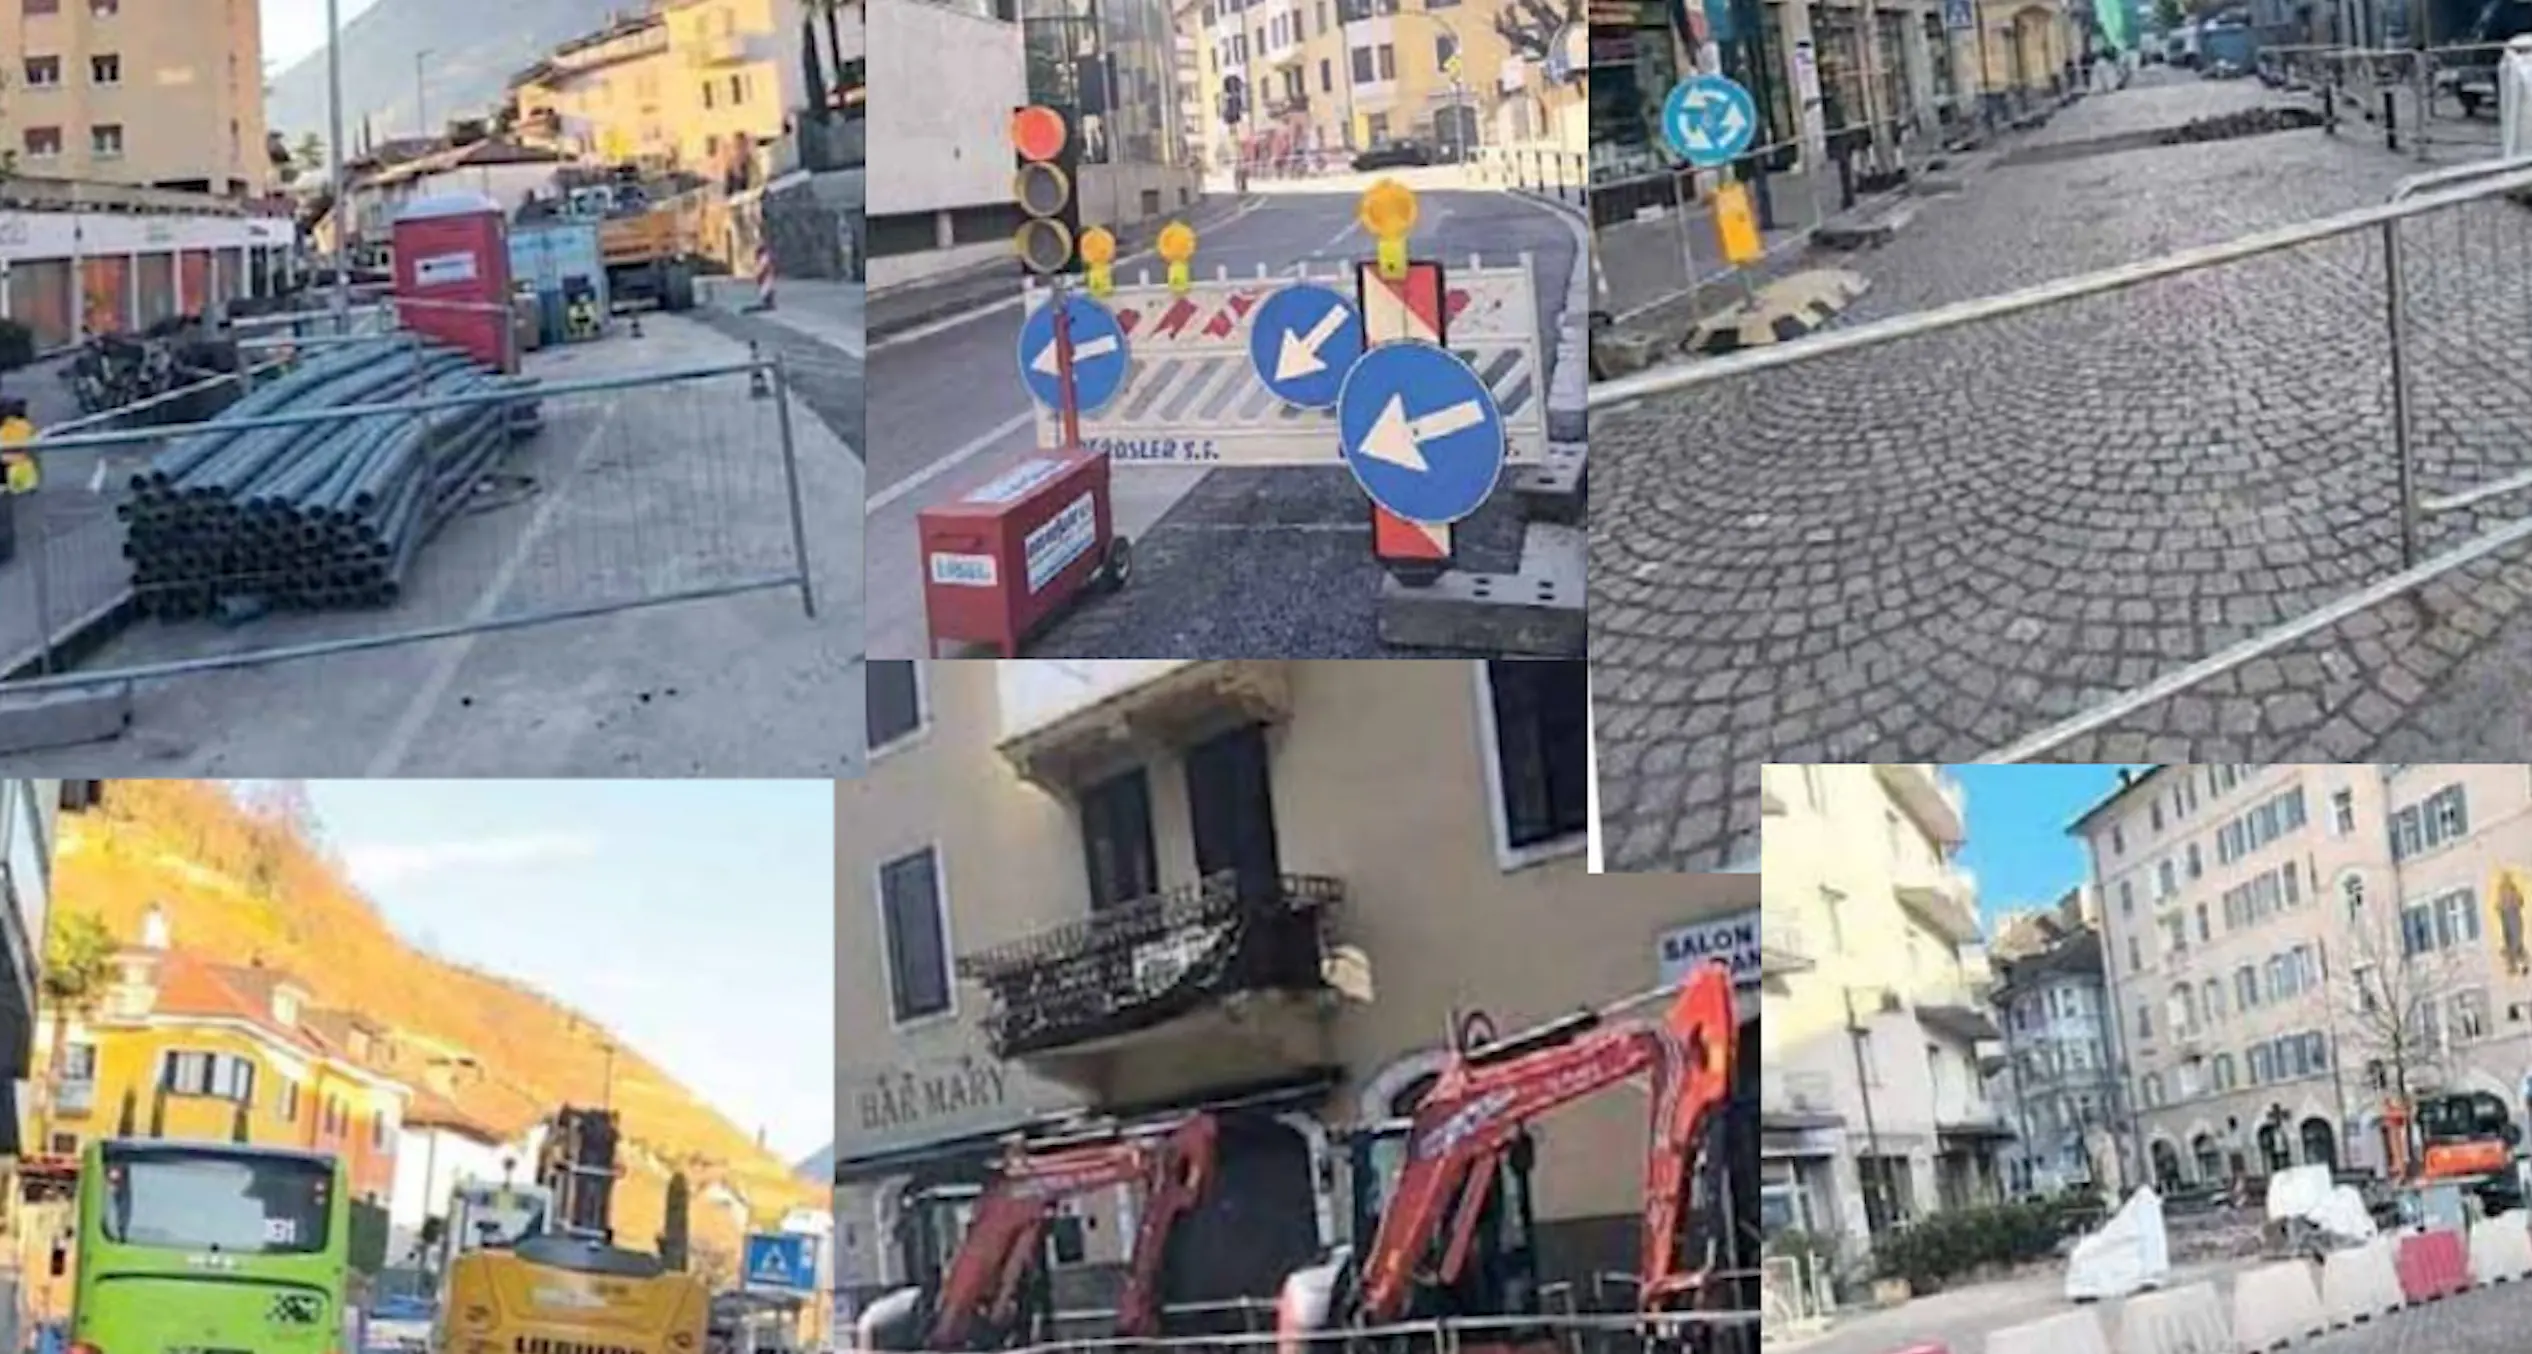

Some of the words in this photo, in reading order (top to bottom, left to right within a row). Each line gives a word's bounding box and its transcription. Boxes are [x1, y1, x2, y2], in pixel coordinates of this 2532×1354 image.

[1664, 923, 1752, 961] SALON
[861, 1087, 918, 1130] BAR
[923, 1063, 1005, 1113] MARY
[514, 1334, 647, 1354] LIEBH
